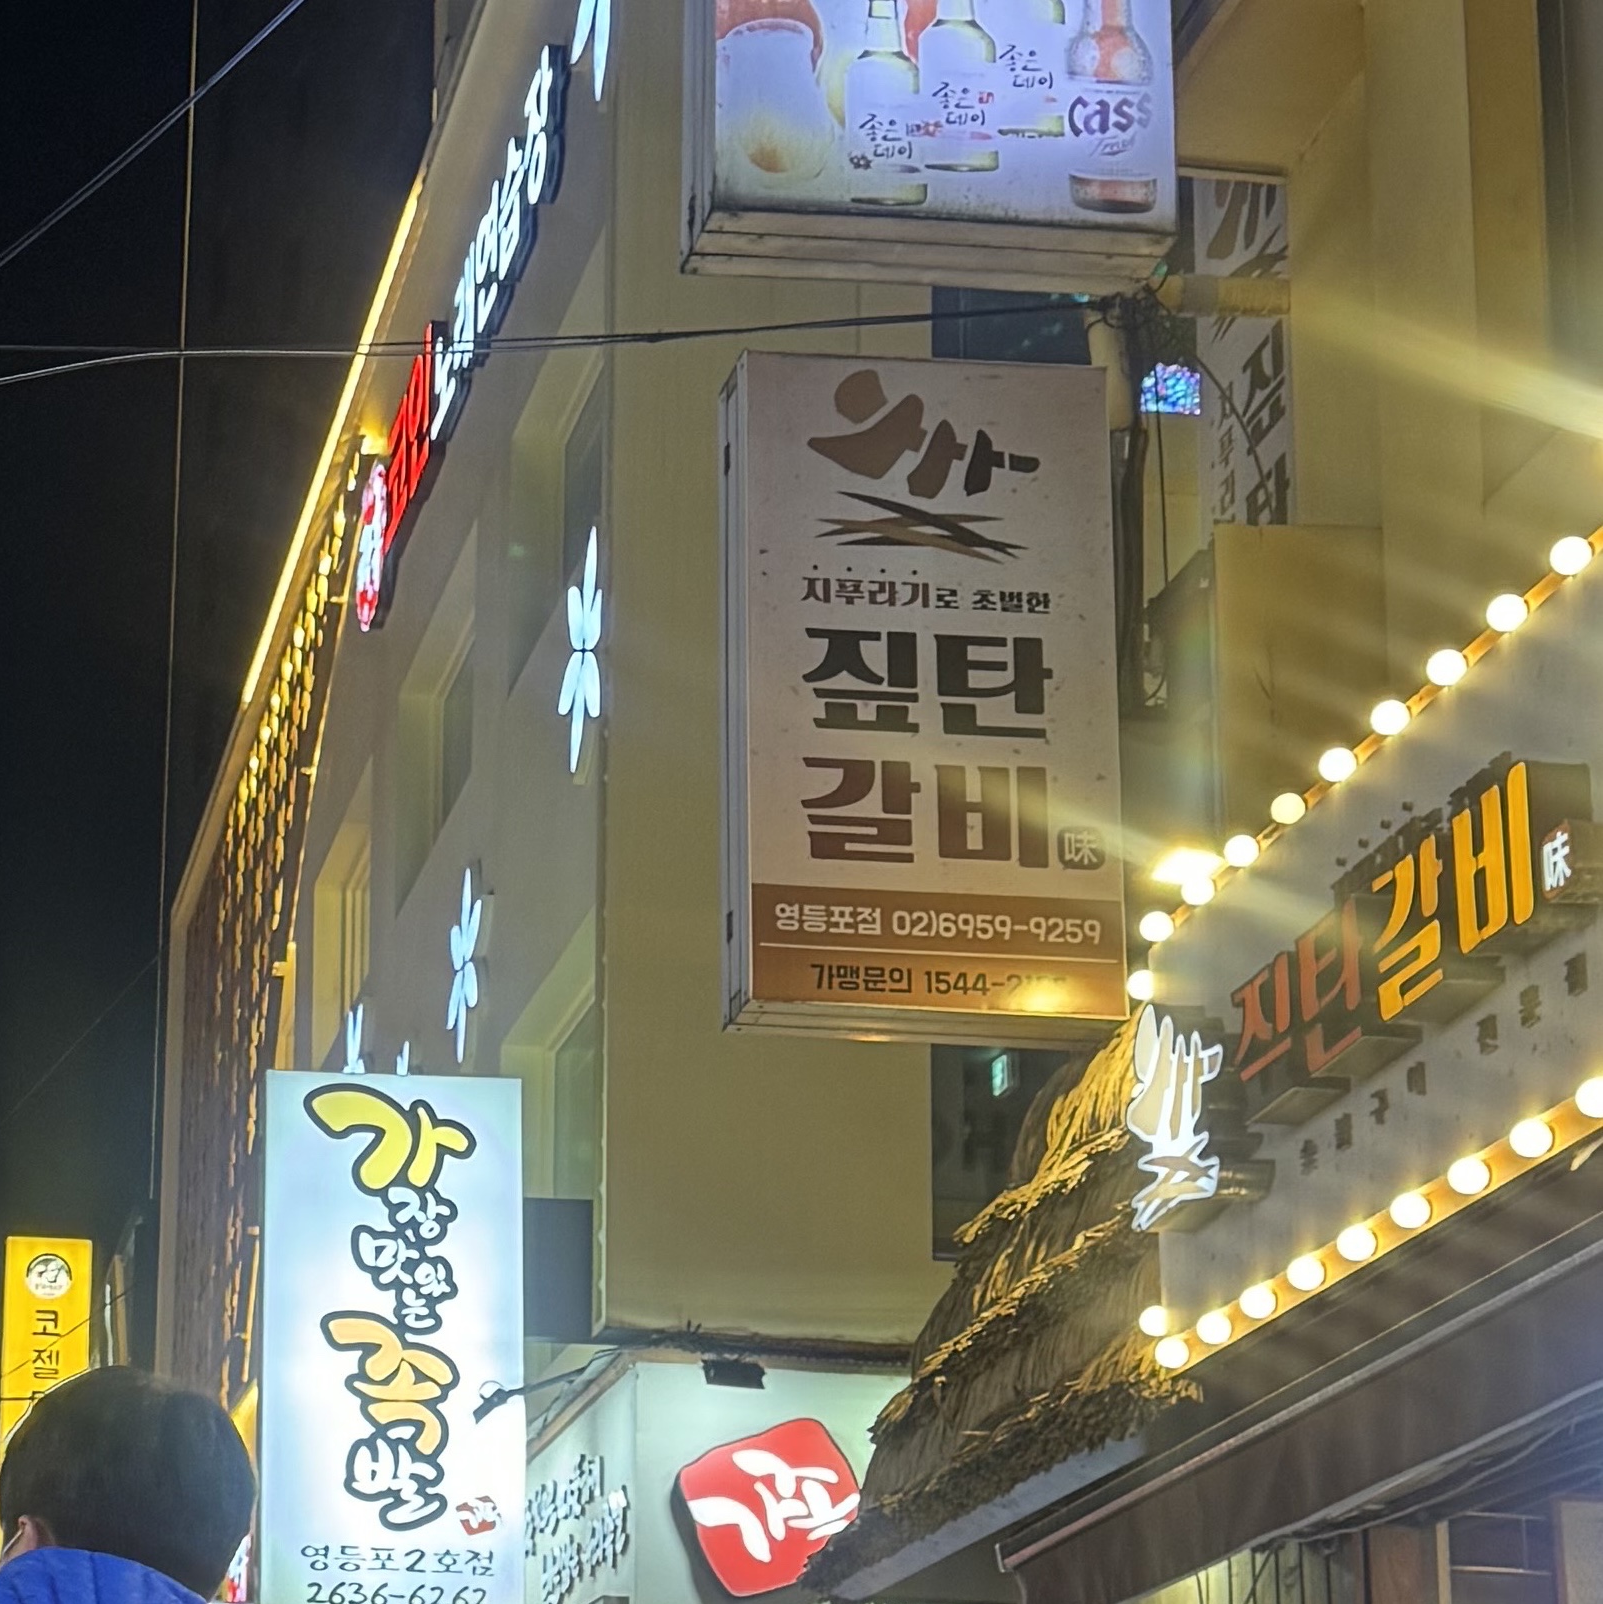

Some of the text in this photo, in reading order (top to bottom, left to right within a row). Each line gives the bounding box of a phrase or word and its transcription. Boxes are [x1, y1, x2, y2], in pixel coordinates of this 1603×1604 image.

[999, 44, 1042, 74] 좋은
[931, 81, 976, 110] 좋은
[1013, 71, 1054, 91] 데이
[858, 113, 898, 142] 좋은
[945, 106, 986, 127] 데이
[873, 139, 913, 160] 데이
[801, 575, 1052, 615] 지푸라기로 초벌한
[801, 626, 1054, 739] 짚탄
[800, 756, 1050, 869] 갈비
[773, 902, 1103, 946] 영등포점 02)6959-9259
[810, 963, 913, 995] 가맹문의
[300, 1543, 495, 1578] 영등포2호점
